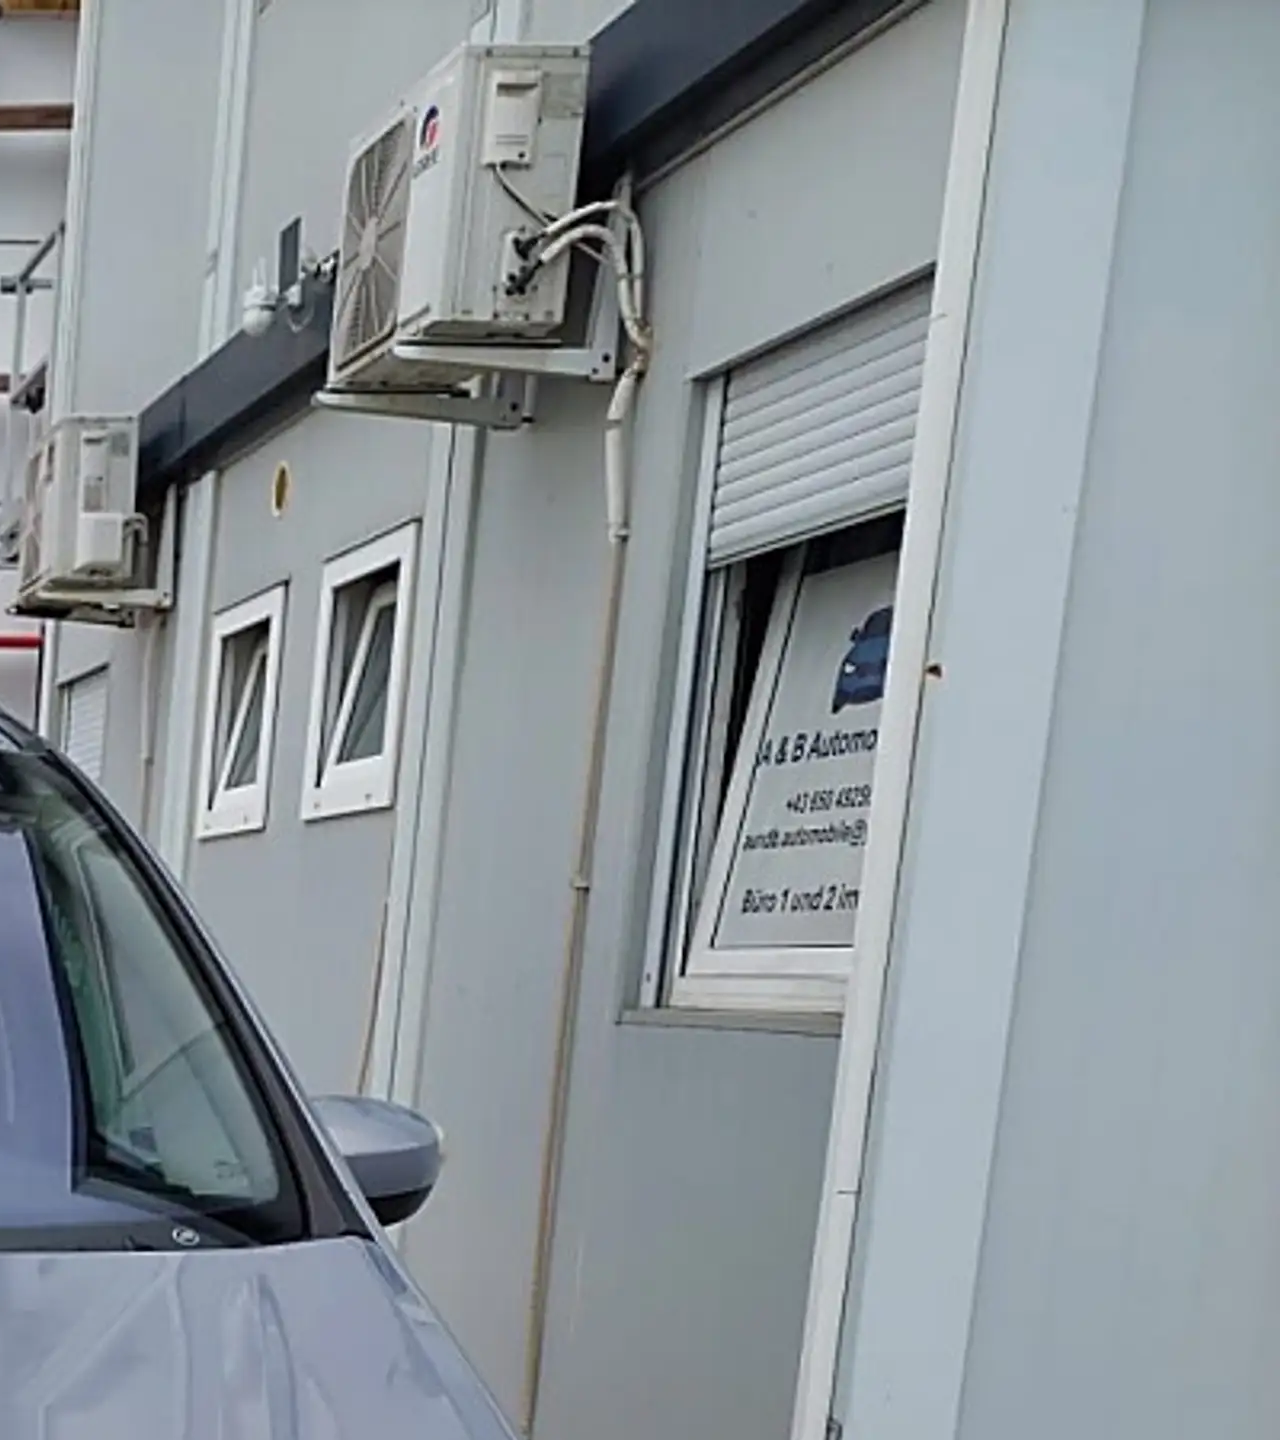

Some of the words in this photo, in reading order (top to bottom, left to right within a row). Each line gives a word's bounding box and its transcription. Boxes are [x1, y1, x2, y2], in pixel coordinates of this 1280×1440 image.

[775, 736, 789, 765] &
[791, 732, 808, 763] B
[780, 886, 791, 912] 1
[791, 886, 825, 912] und
[822, 884, 838, 912] 2
